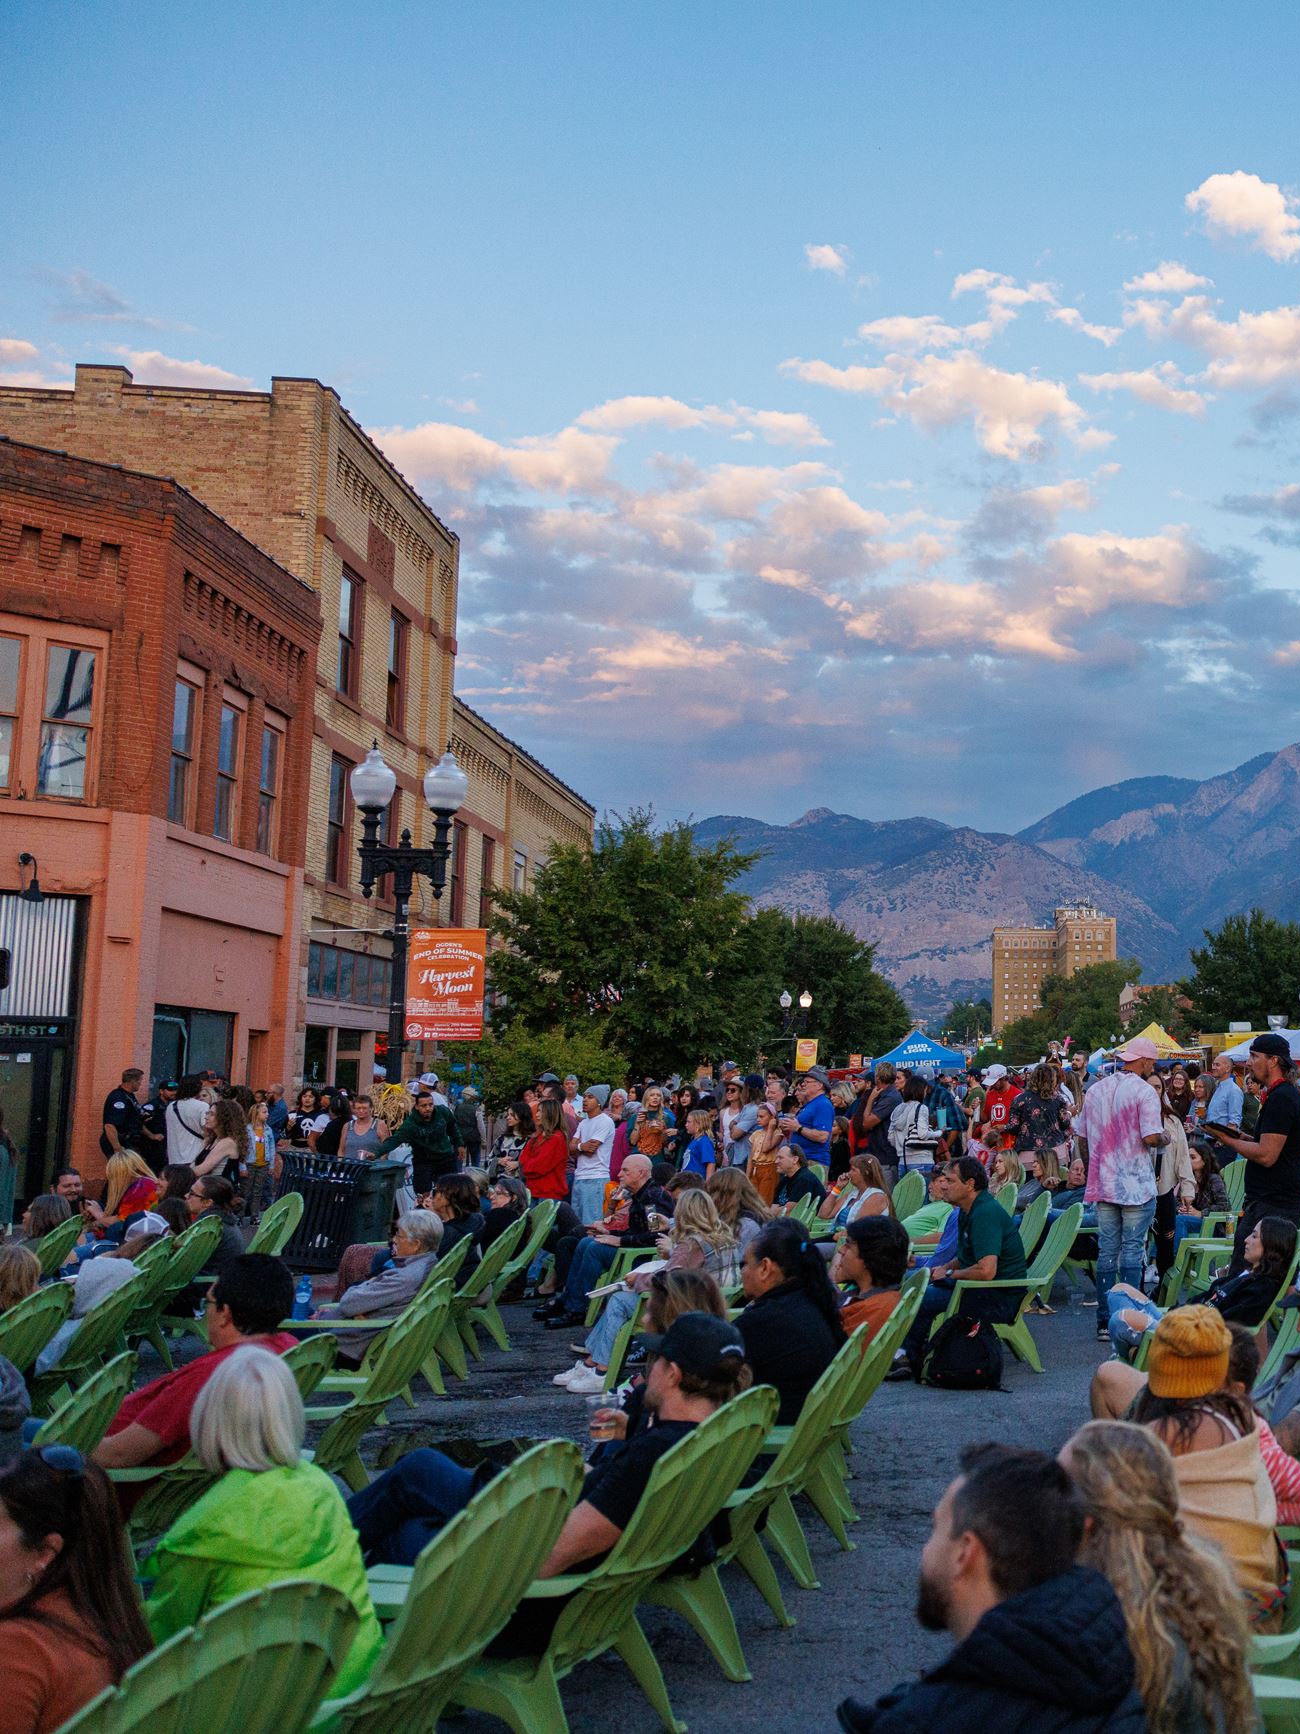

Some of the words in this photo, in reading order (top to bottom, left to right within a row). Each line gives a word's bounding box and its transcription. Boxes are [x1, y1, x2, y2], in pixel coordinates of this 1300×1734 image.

[413, 950, 431, 961] END
[446, 947, 483, 961] SUMMER
[418, 964, 476, 985] Harvest
[432, 980, 474, 998] Moon
[29, 1025, 47, 1035] ST
[895, 1060, 914, 1069] BUD
[915, 1060, 941, 1068] LIGHT
